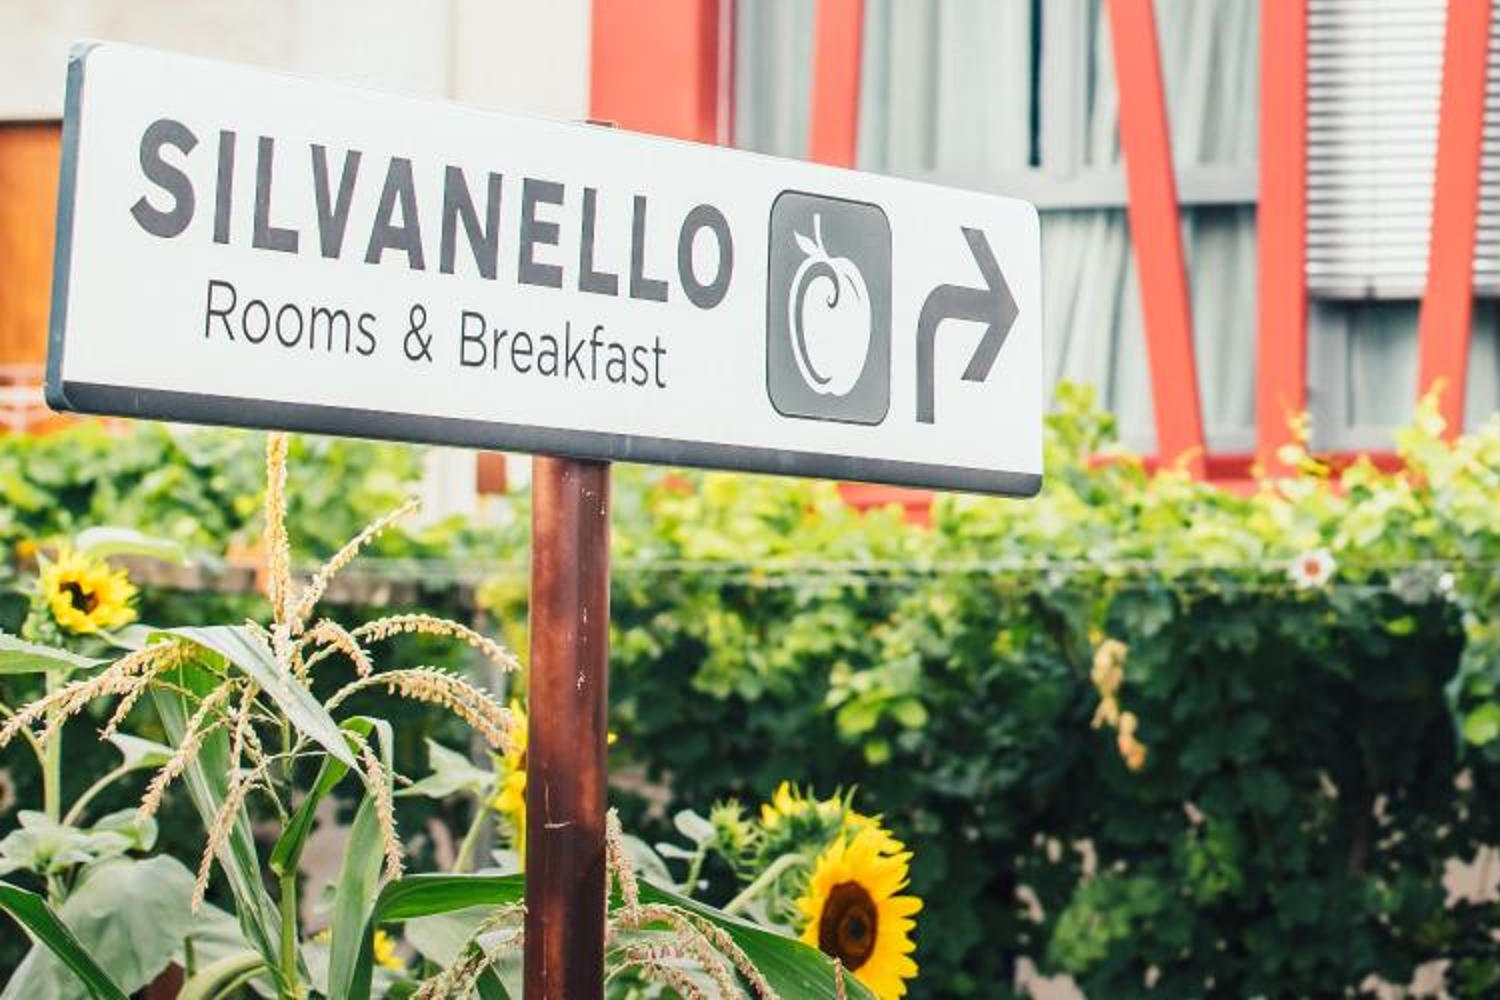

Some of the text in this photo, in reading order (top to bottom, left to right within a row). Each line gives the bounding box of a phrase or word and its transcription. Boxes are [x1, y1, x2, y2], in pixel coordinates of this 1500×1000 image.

[129, 119, 734, 310] SILVANELLO
[204, 279, 667, 389] Rooms & Breakfast
